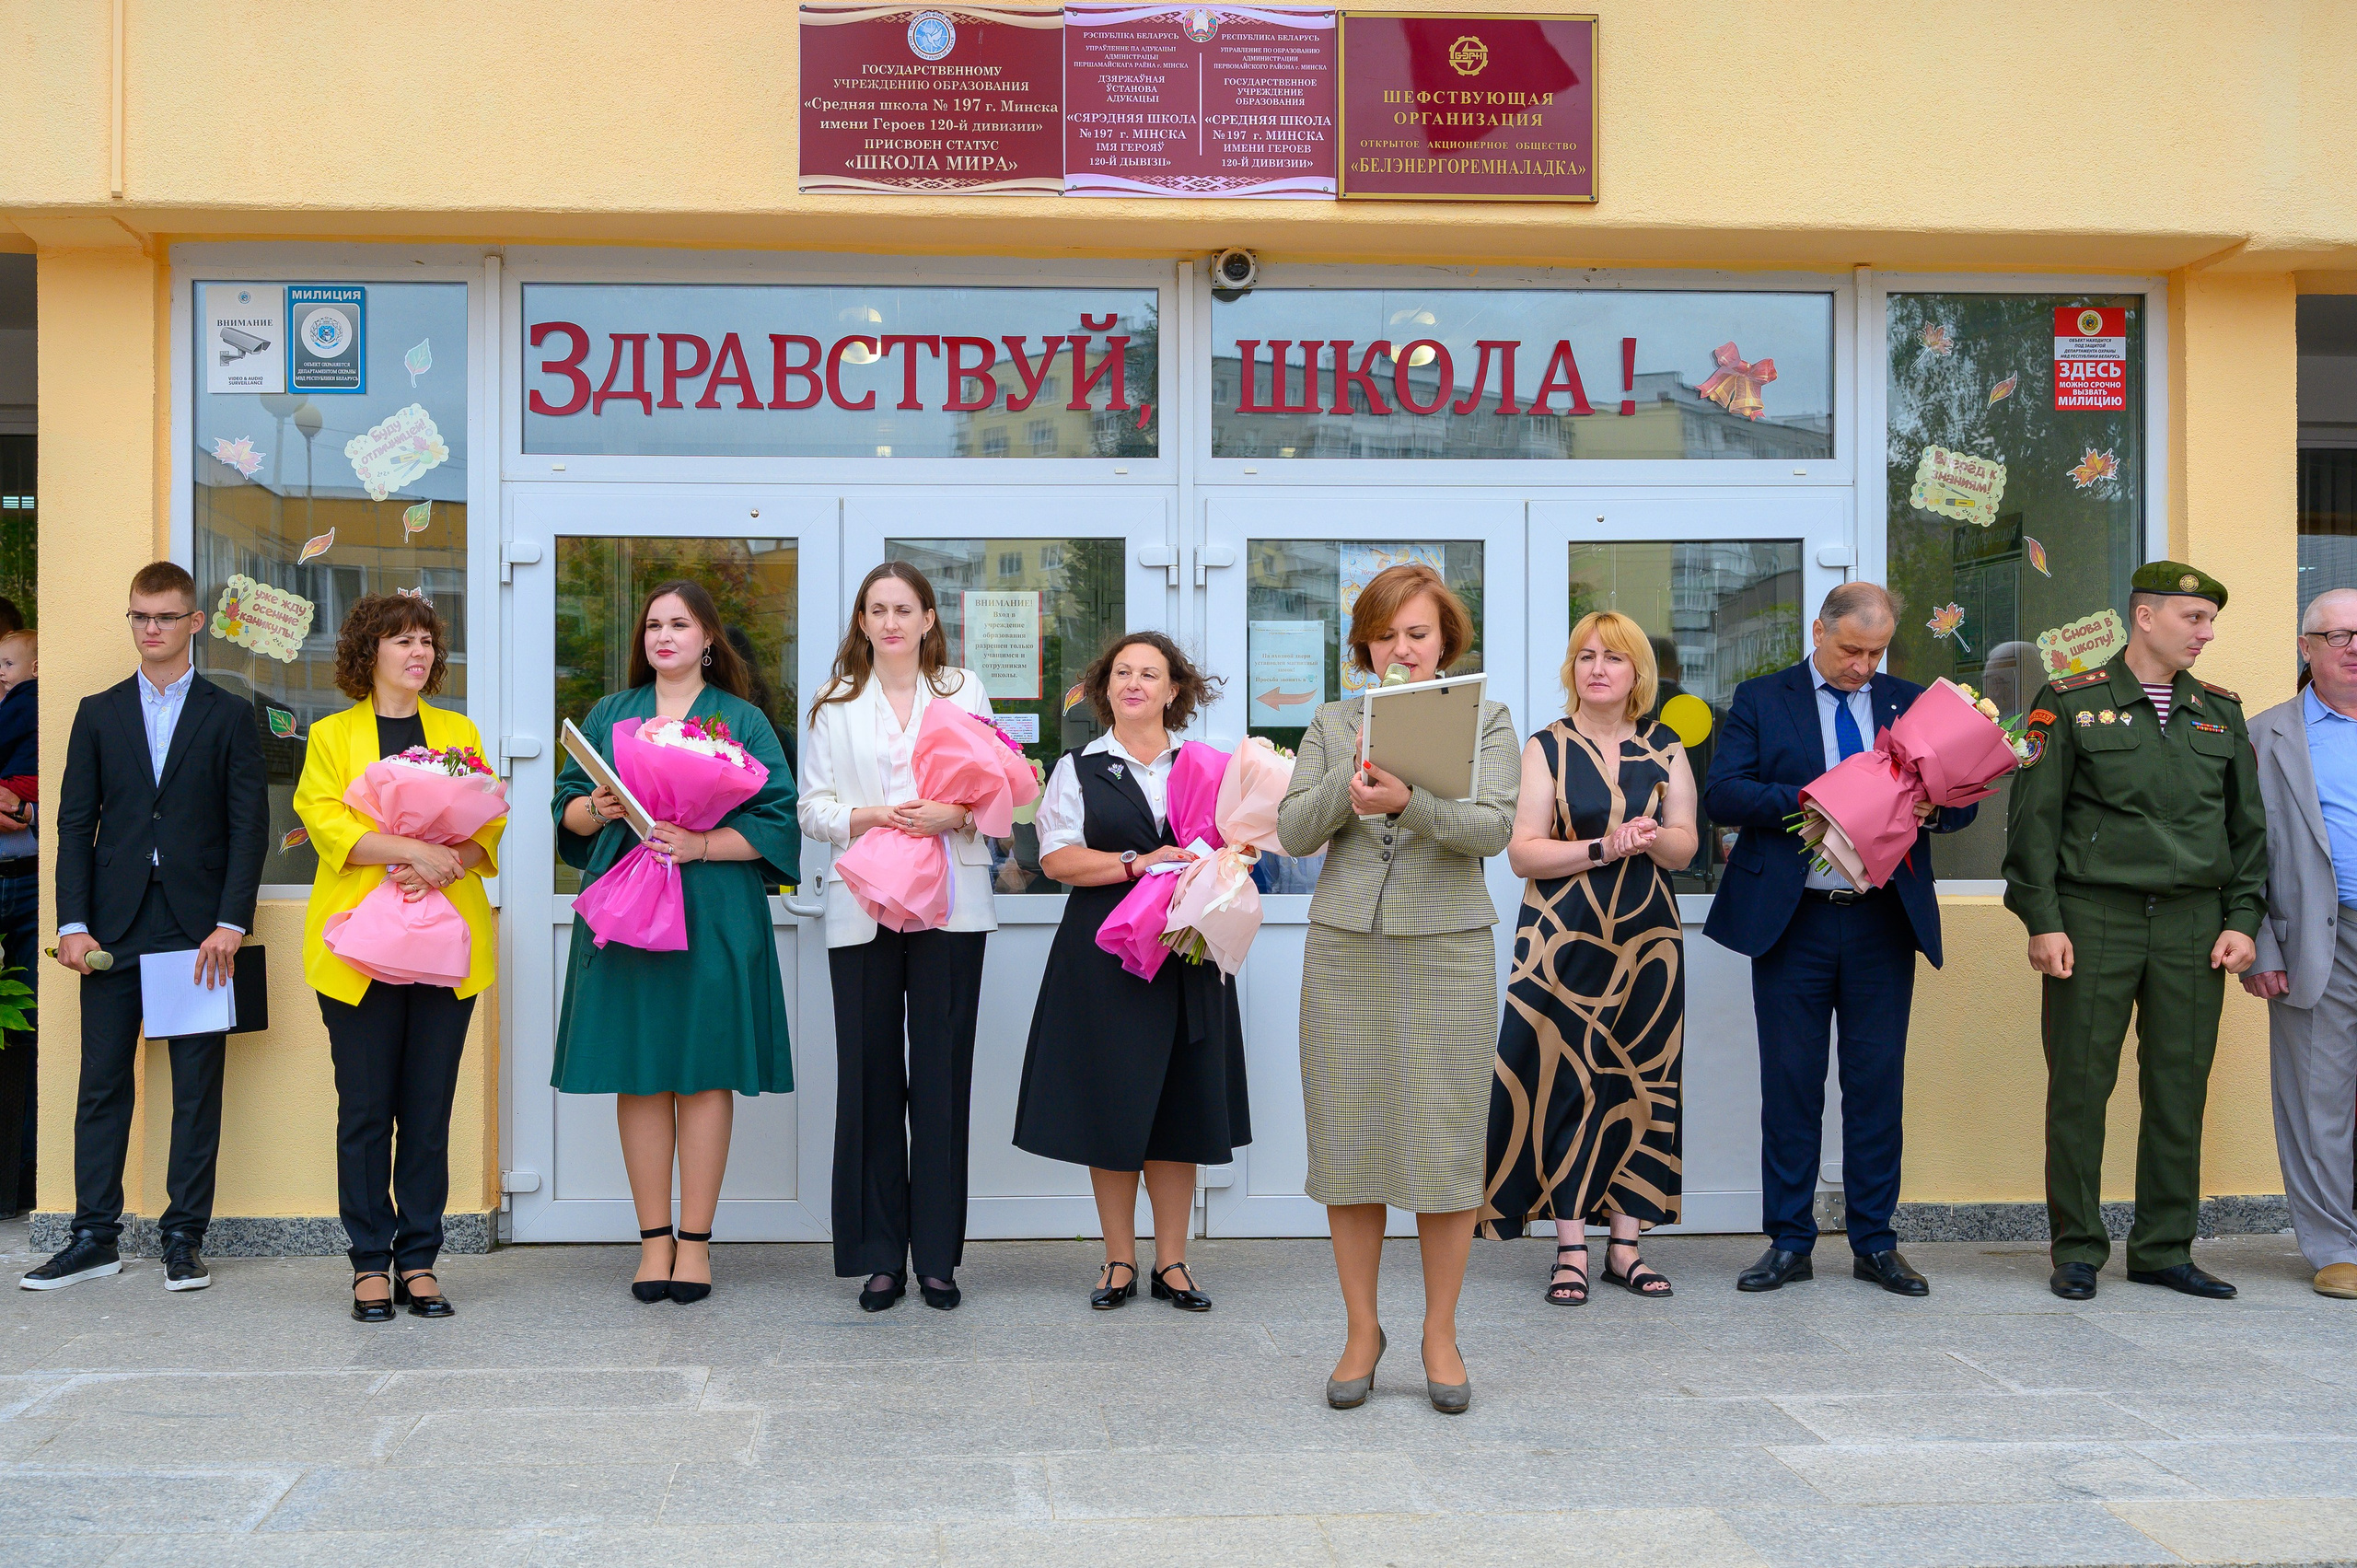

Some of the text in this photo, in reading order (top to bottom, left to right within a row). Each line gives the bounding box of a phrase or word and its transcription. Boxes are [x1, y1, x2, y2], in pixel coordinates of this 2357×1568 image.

[862, 64, 1002, 75] ГОСУДАРСТВЕННОМУ
[1098, 74, 1165, 83] ДЗЯРЖАЎНАЯ
[1224, 78, 1317, 87] ГОСУДАРСТВЕННОЕ
[833, 79, 1028, 91] УЧРЕЖДЕНИЮ ОБРАЗОВАНИЯ
[1107, 83, 1157, 92] ЎСТАНОВА
[1237, 88, 1303, 97] УЧРЕЖДЕНИЕ
[1107, 95, 1159, 103] АДУКАЦЫІ
[1383, 90, 1554, 107] ШЕФСТВУЮЩАЯ
[805, 98, 1058, 112] «Средняя школа № 197 г. Минска
[1067, 113, 1197, 124] «СЯРЭДНЯЯ ШКОЛА
[1205, 115, 1331, 126] «СРЕДНЯЯ ШКОЛА
[1394, 111, 1543, 128] ОРГАНИЗАЦИЯ
[820, 118, 1042, 132] имени Героев 120-й дивизии»
[1132, 129, 1187, 139] МІНСКА
[1265, 131, 1324, 141] МИНСКА
[865, 139, 999, 151] ПРИСВОЕН СТАТУС
[1120, 142, 1165, 151] ГЕРОЯЎ
[1268, 145, 1311, 153] ГЕРОЕВ
[1360, 140, 1420, 148] ОТКРЫТОЕ
[1427, 141, 1509, 150] АКЦИОНЕРНОЕ
[845, 155, 1017, 171] «ШКОЛА МИРА»
[1089, 155, 1117, 165] 120-Й
[1222, 157, 1313, 168] 120-Й ДИВИЗИИ»
[1351, 157, 1586, 178] «БЕЛЭНЕРГОРЕМНАЛАДКА»
[292, 290, 361, 301] МИЛИЦИЯ
[2060, 363, 2121, 380] ЗДЕСЬ
[2059, 397, 2122, 407] МИЛИЦИЮ
[370, 421, 401, 442] Буду
[1931, 470, 1992, 494] знаниям!
[252, 603, 299, 626] осенние
[2061, 621, 2102, 642] Снова
[2069, 629, 2115, 656] школу!
